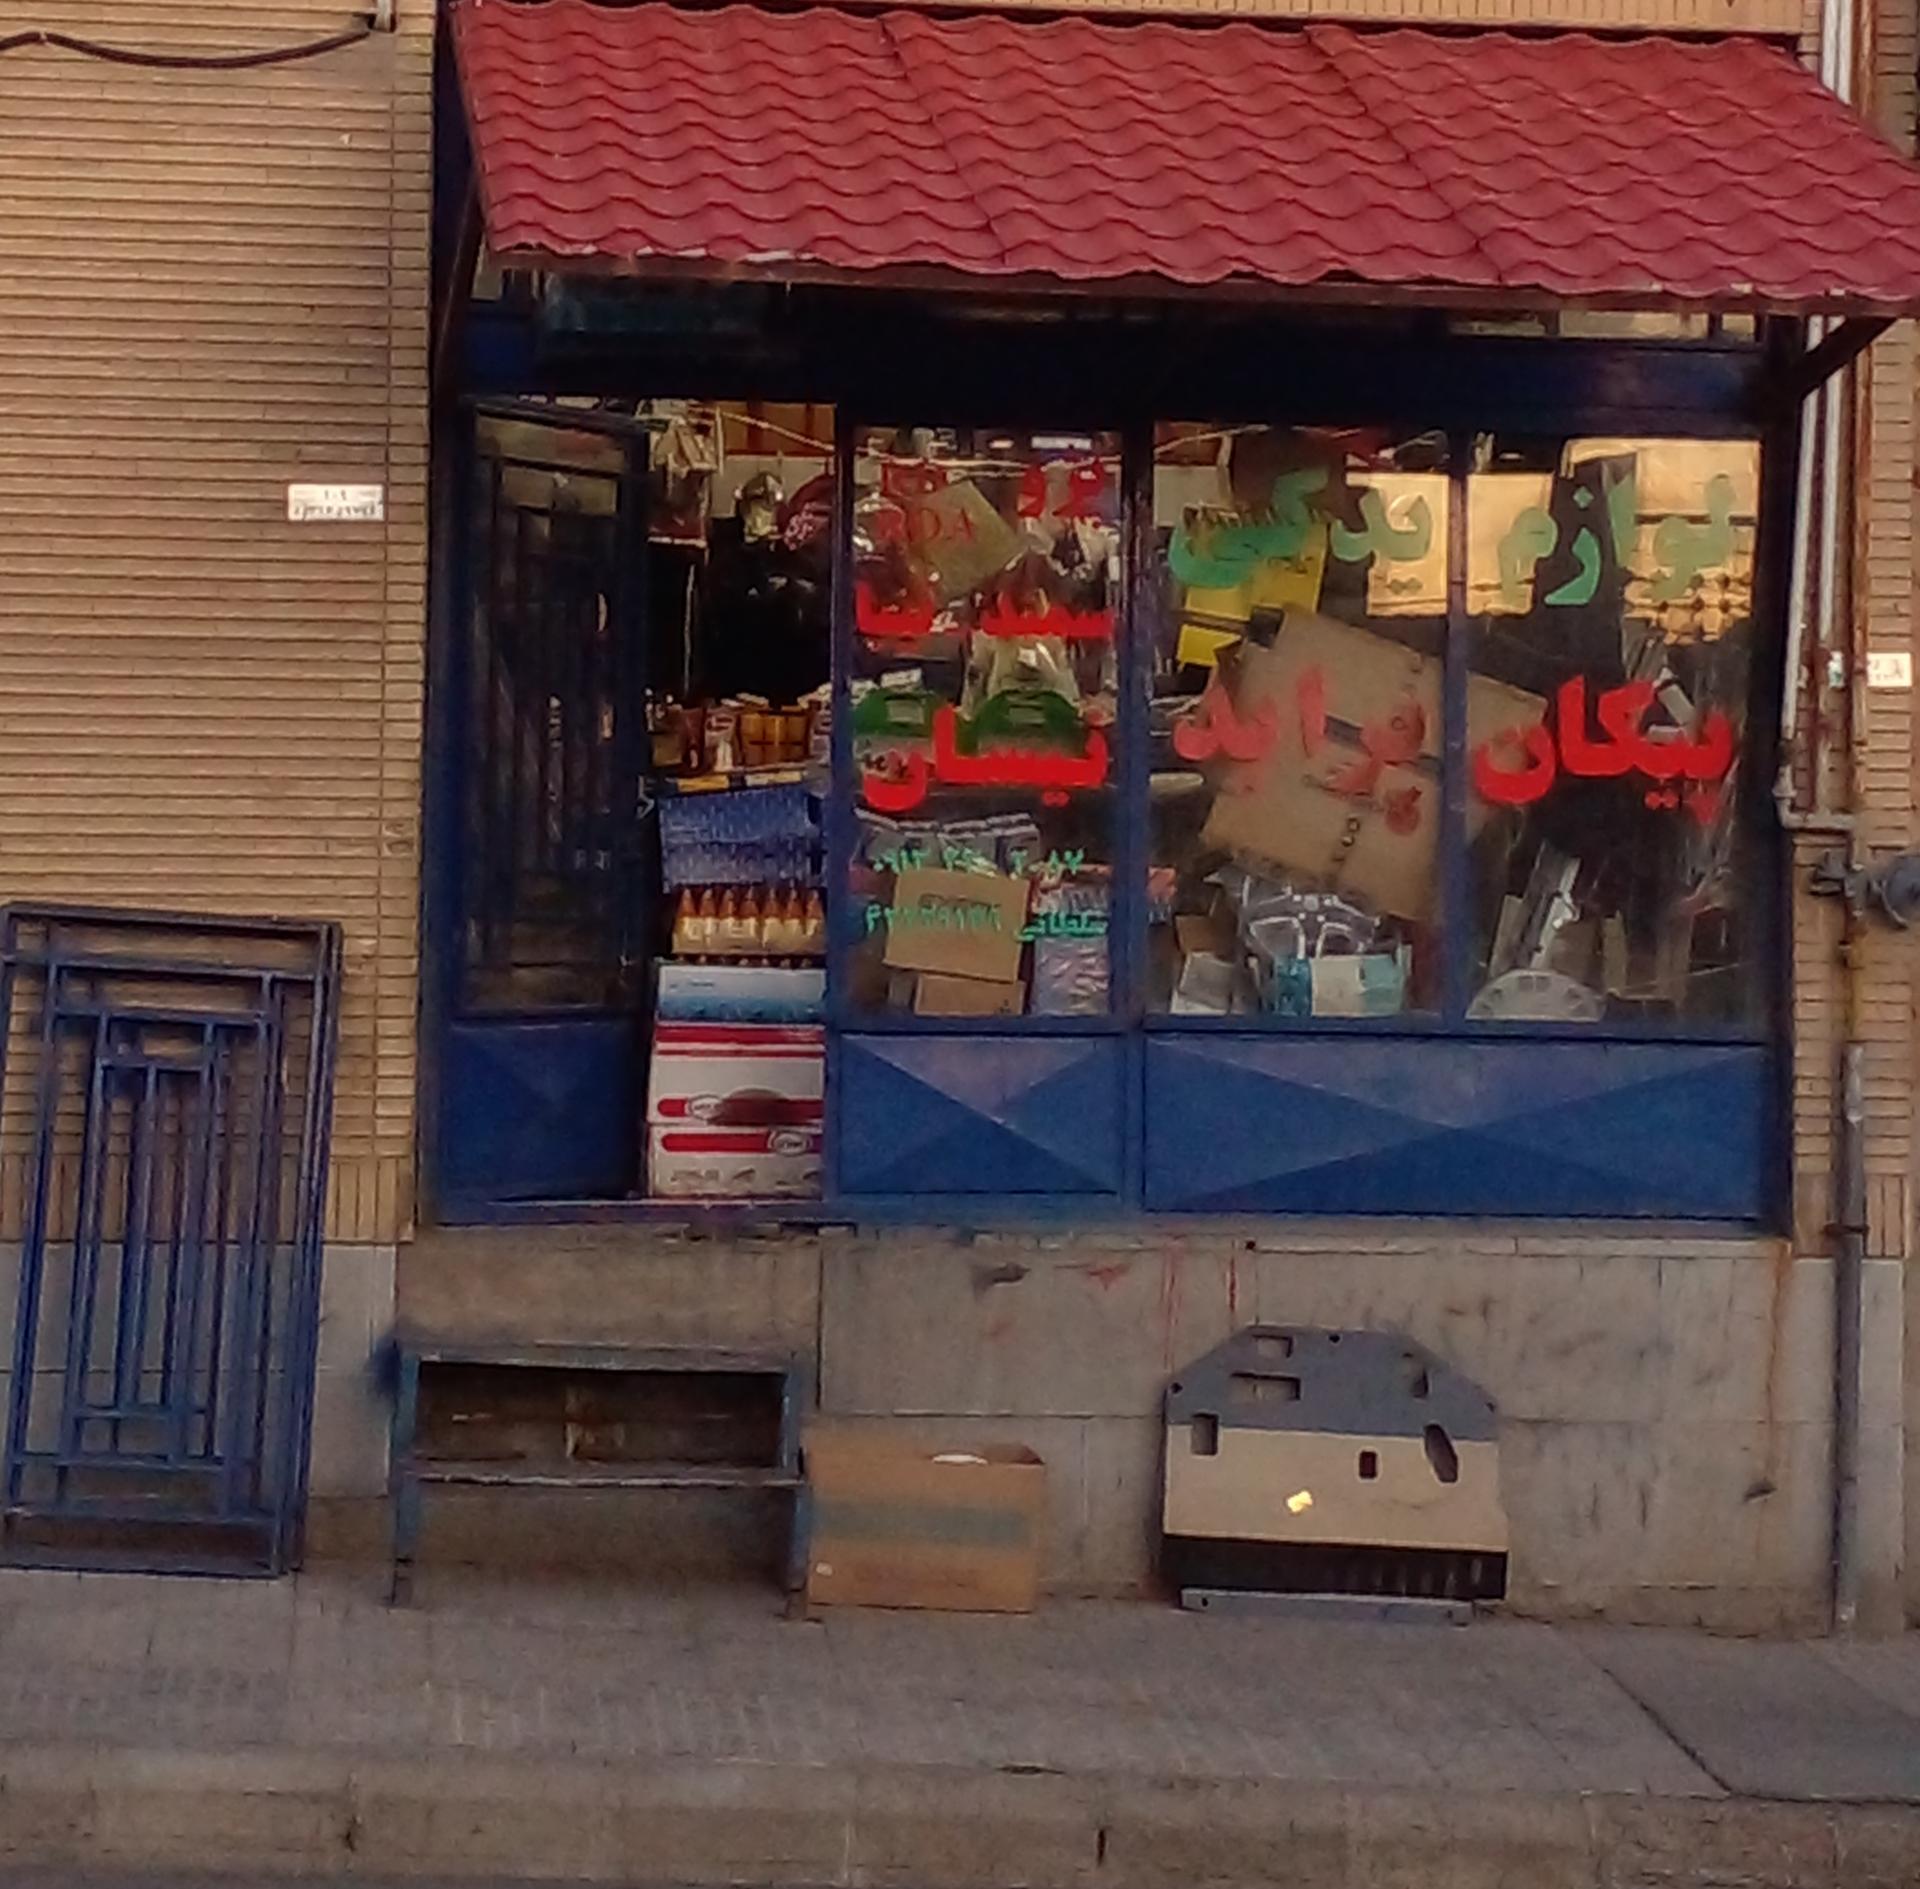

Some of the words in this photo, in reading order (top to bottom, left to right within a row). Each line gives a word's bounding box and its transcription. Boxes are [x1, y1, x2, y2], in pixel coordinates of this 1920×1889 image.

[1167, 466, 1432, 596] یدکی
[1497, 455, 1737, 606] لوازم
[862, 702, 1110, 812] نیسان
[1172, 665, 1427, 836] پراید
[1474, 674, 1733, 825] پیکان
